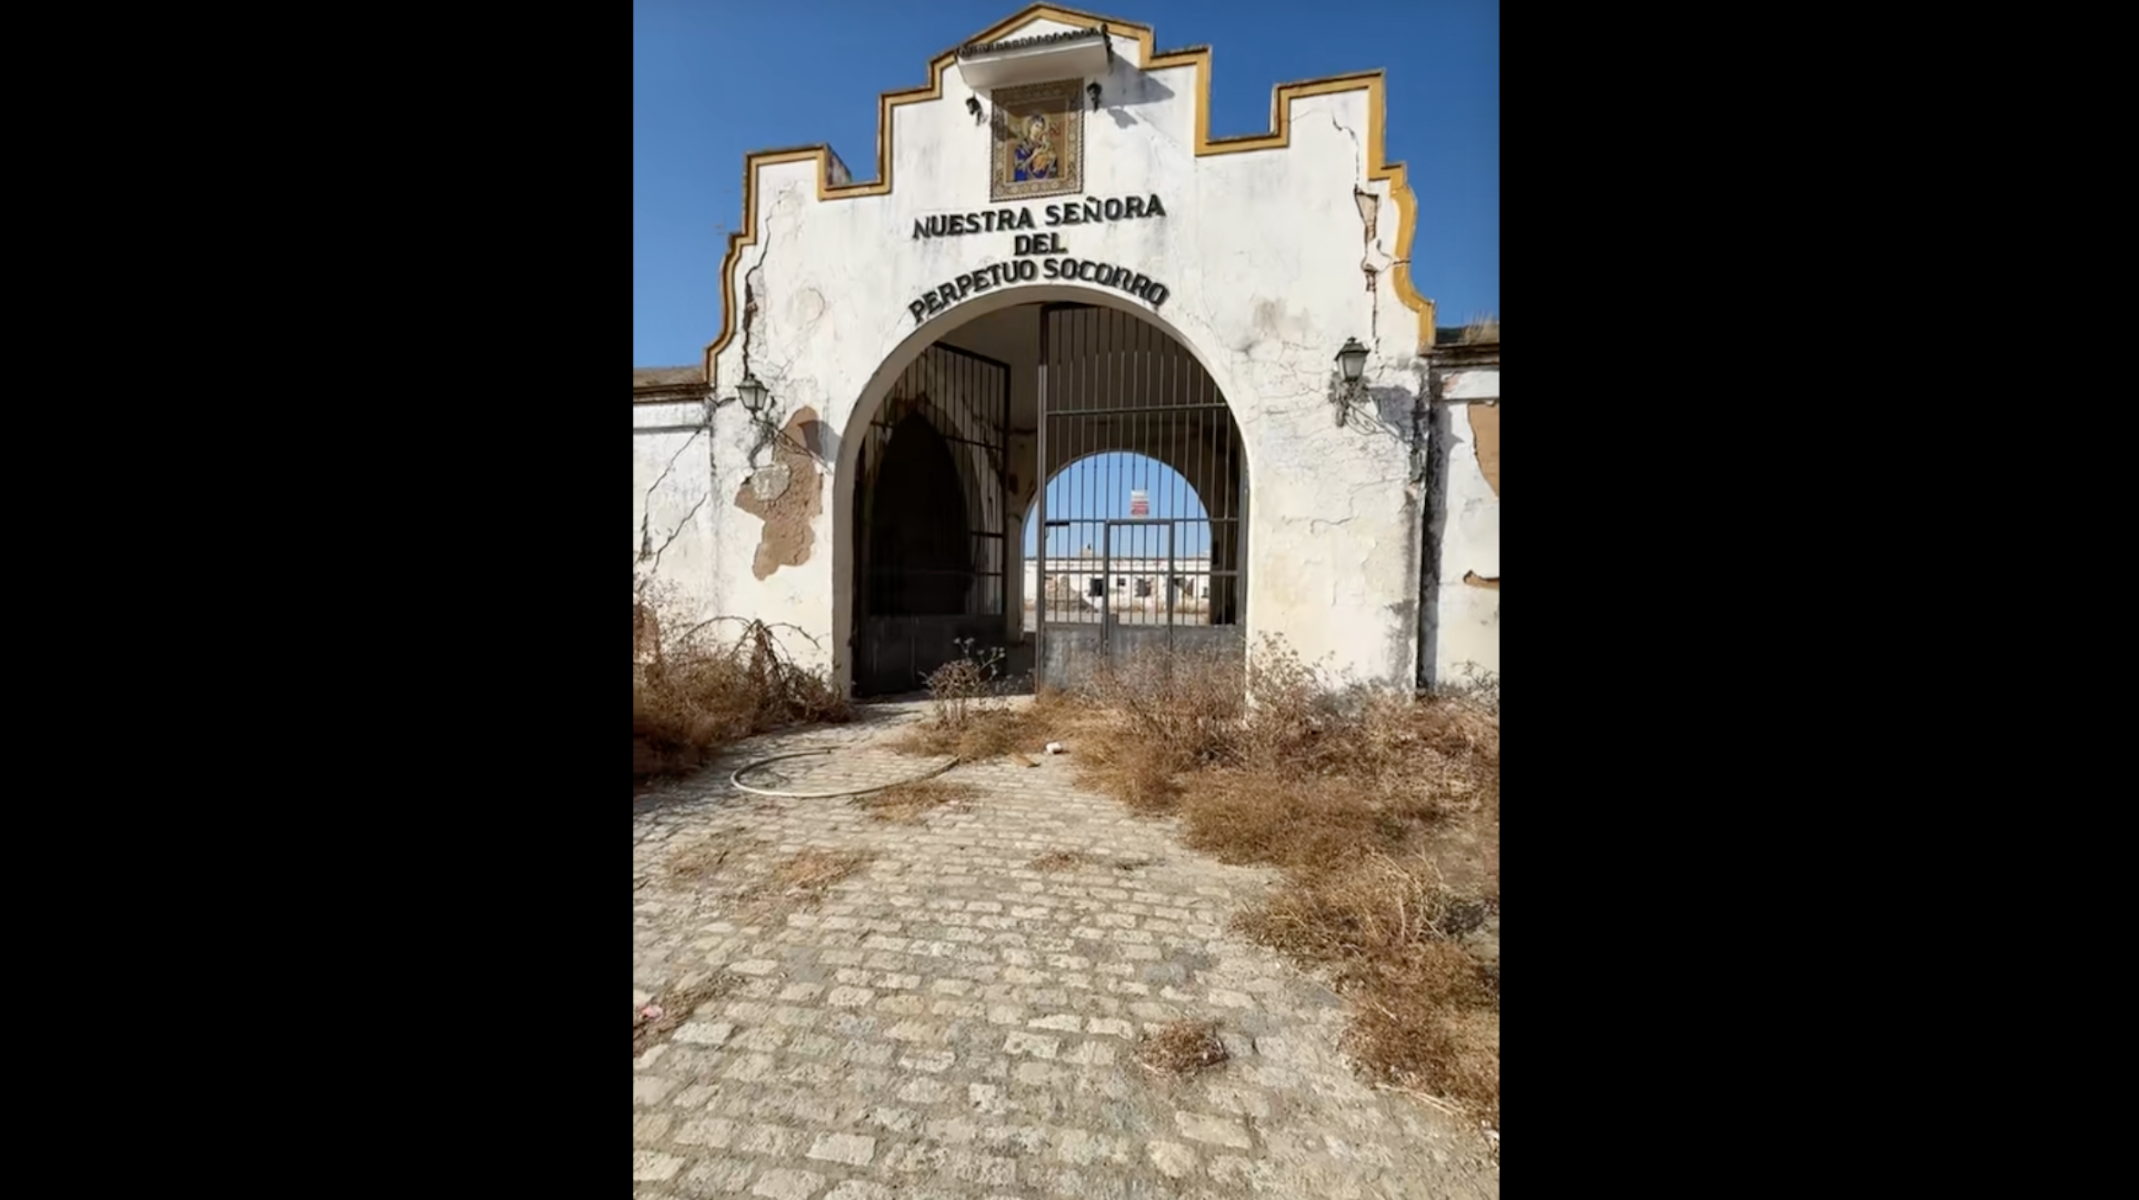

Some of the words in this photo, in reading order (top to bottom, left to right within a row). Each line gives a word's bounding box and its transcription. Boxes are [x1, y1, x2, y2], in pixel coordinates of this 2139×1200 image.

[913, 207, 1034, 240] NUESTRA
[1045, 194, 1166, 226] SEÑORA
[1014, 233, 1068, 256] DEL
[908, 259, 1037, 323] PERPETUO
[1043, 258, 1170, 308] SOCORRO
